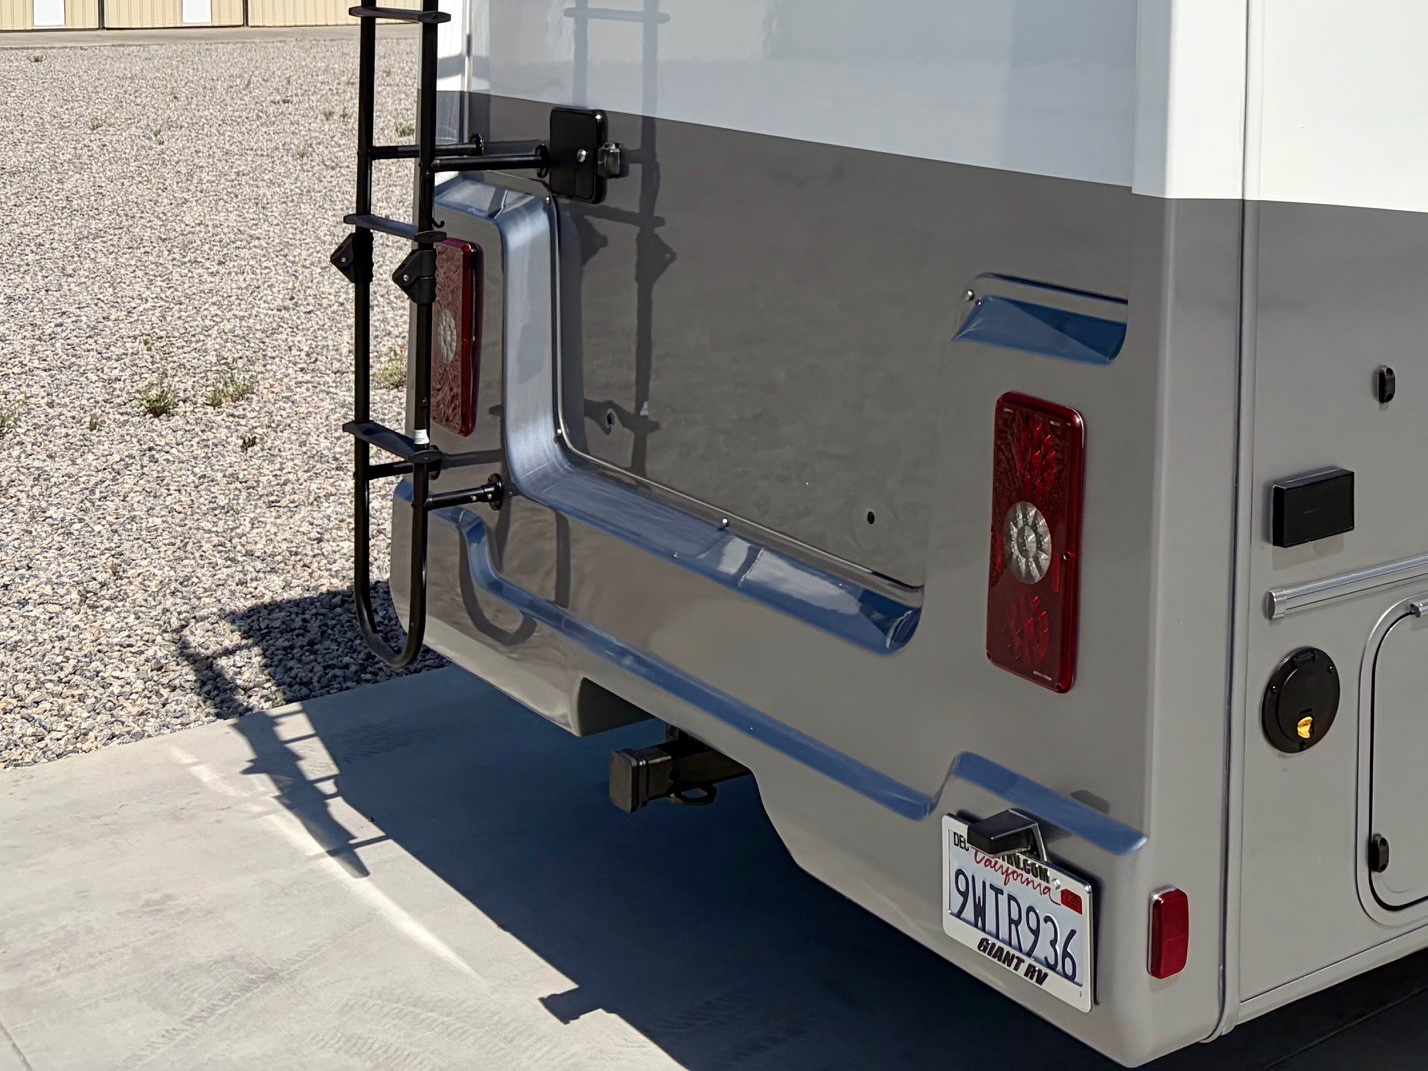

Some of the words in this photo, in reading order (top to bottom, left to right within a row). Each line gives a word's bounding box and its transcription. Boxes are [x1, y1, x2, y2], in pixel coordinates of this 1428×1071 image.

[954, 868, 1077, 983] 9WTR936
[977, 937, 1025, 972] GIANT
[1023, 962, 1050, 986] RV
